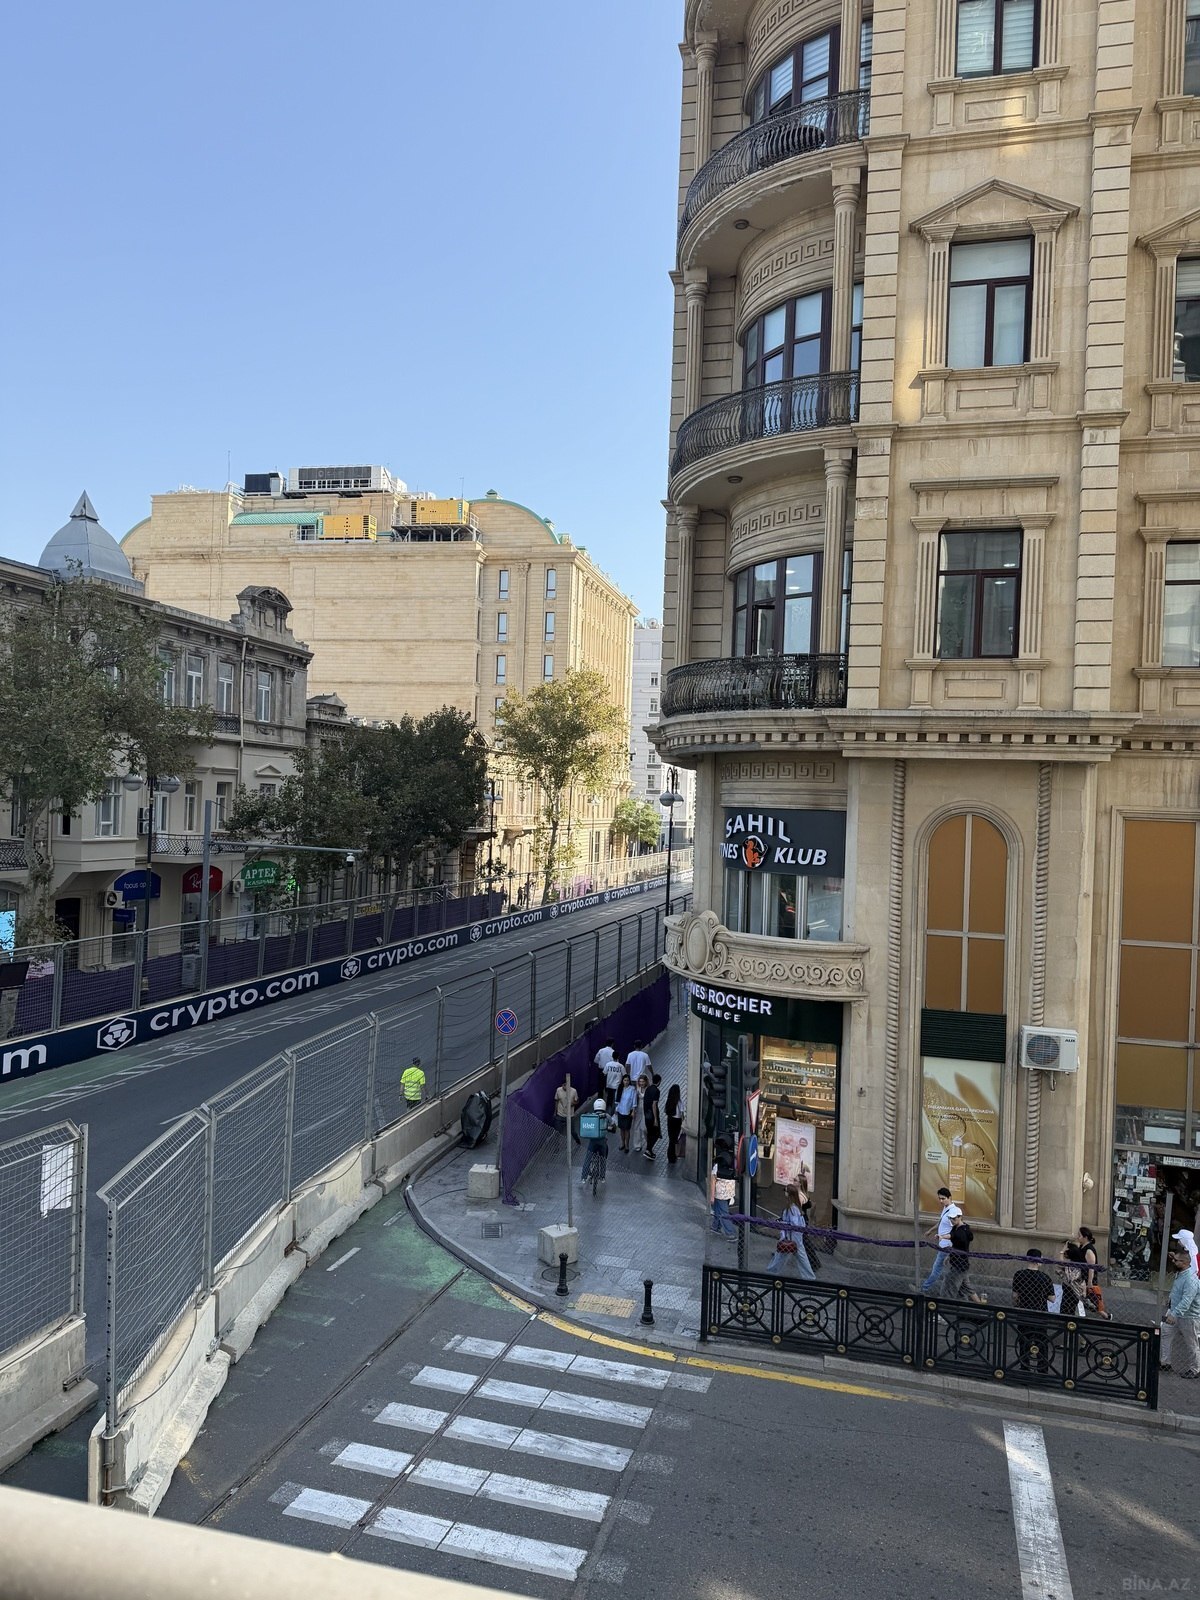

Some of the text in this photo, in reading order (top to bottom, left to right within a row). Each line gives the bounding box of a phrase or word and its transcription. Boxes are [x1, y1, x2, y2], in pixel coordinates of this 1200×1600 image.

[725, 813, 791, 843] SAHIL
[774, 847, 827, 866] KLUB
[560, 894, 599, 914] crypto.com
[611, 884, 640, 899] crypto.com
[485, 909, 542, 935] crypto.com
[367, 933, 458, 969] crypto.com
[150, 970, 319, 1031] crypto.com
[697, 1003, 741, 1022] FRANCE
[708, 989, 772, 1015] ROCHER
